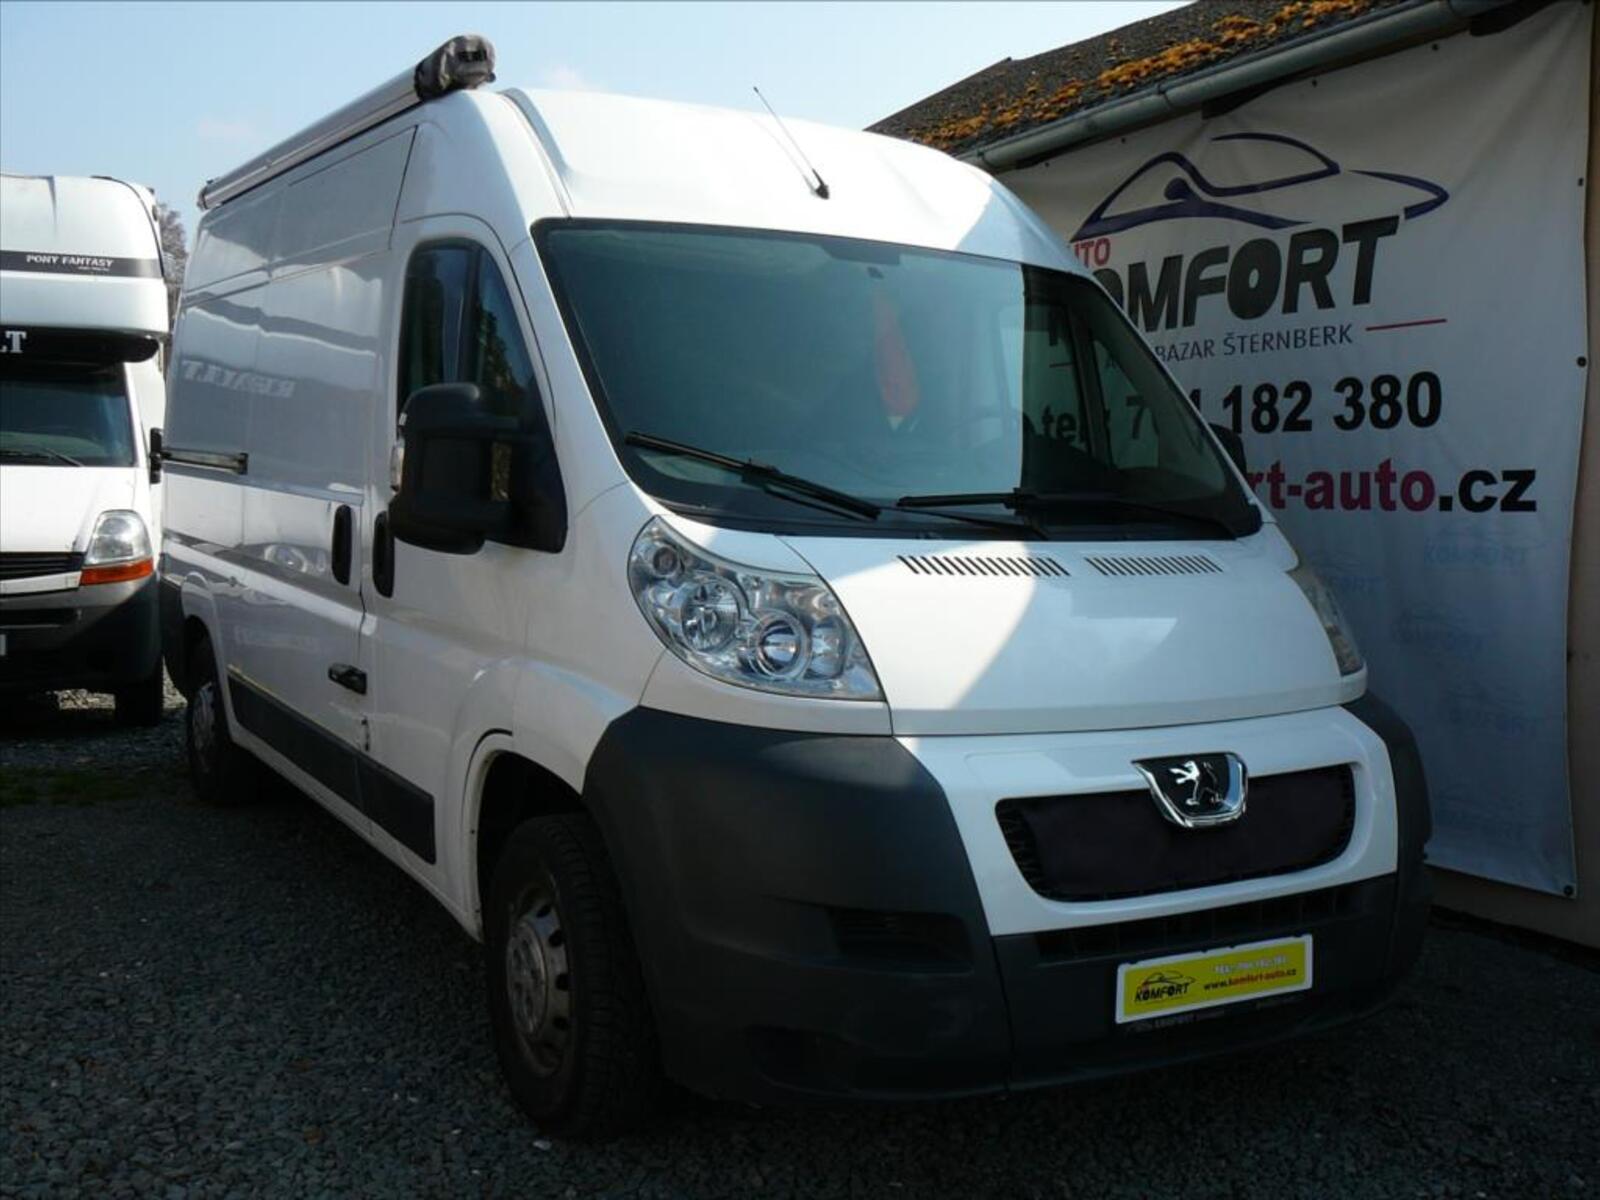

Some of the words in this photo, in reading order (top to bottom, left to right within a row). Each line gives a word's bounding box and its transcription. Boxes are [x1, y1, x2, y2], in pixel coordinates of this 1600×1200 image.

[26, 254, 60, 265] PONY
[62, 255, 114, 267] FANTASY
[1223, 322, 1353, 357] ŠTERNBERK
[1222, 382, 1313, 435] 182
[1333, 370, 1442, 430] 380
[1134, 981, 1191, 1003] KOMFORT
